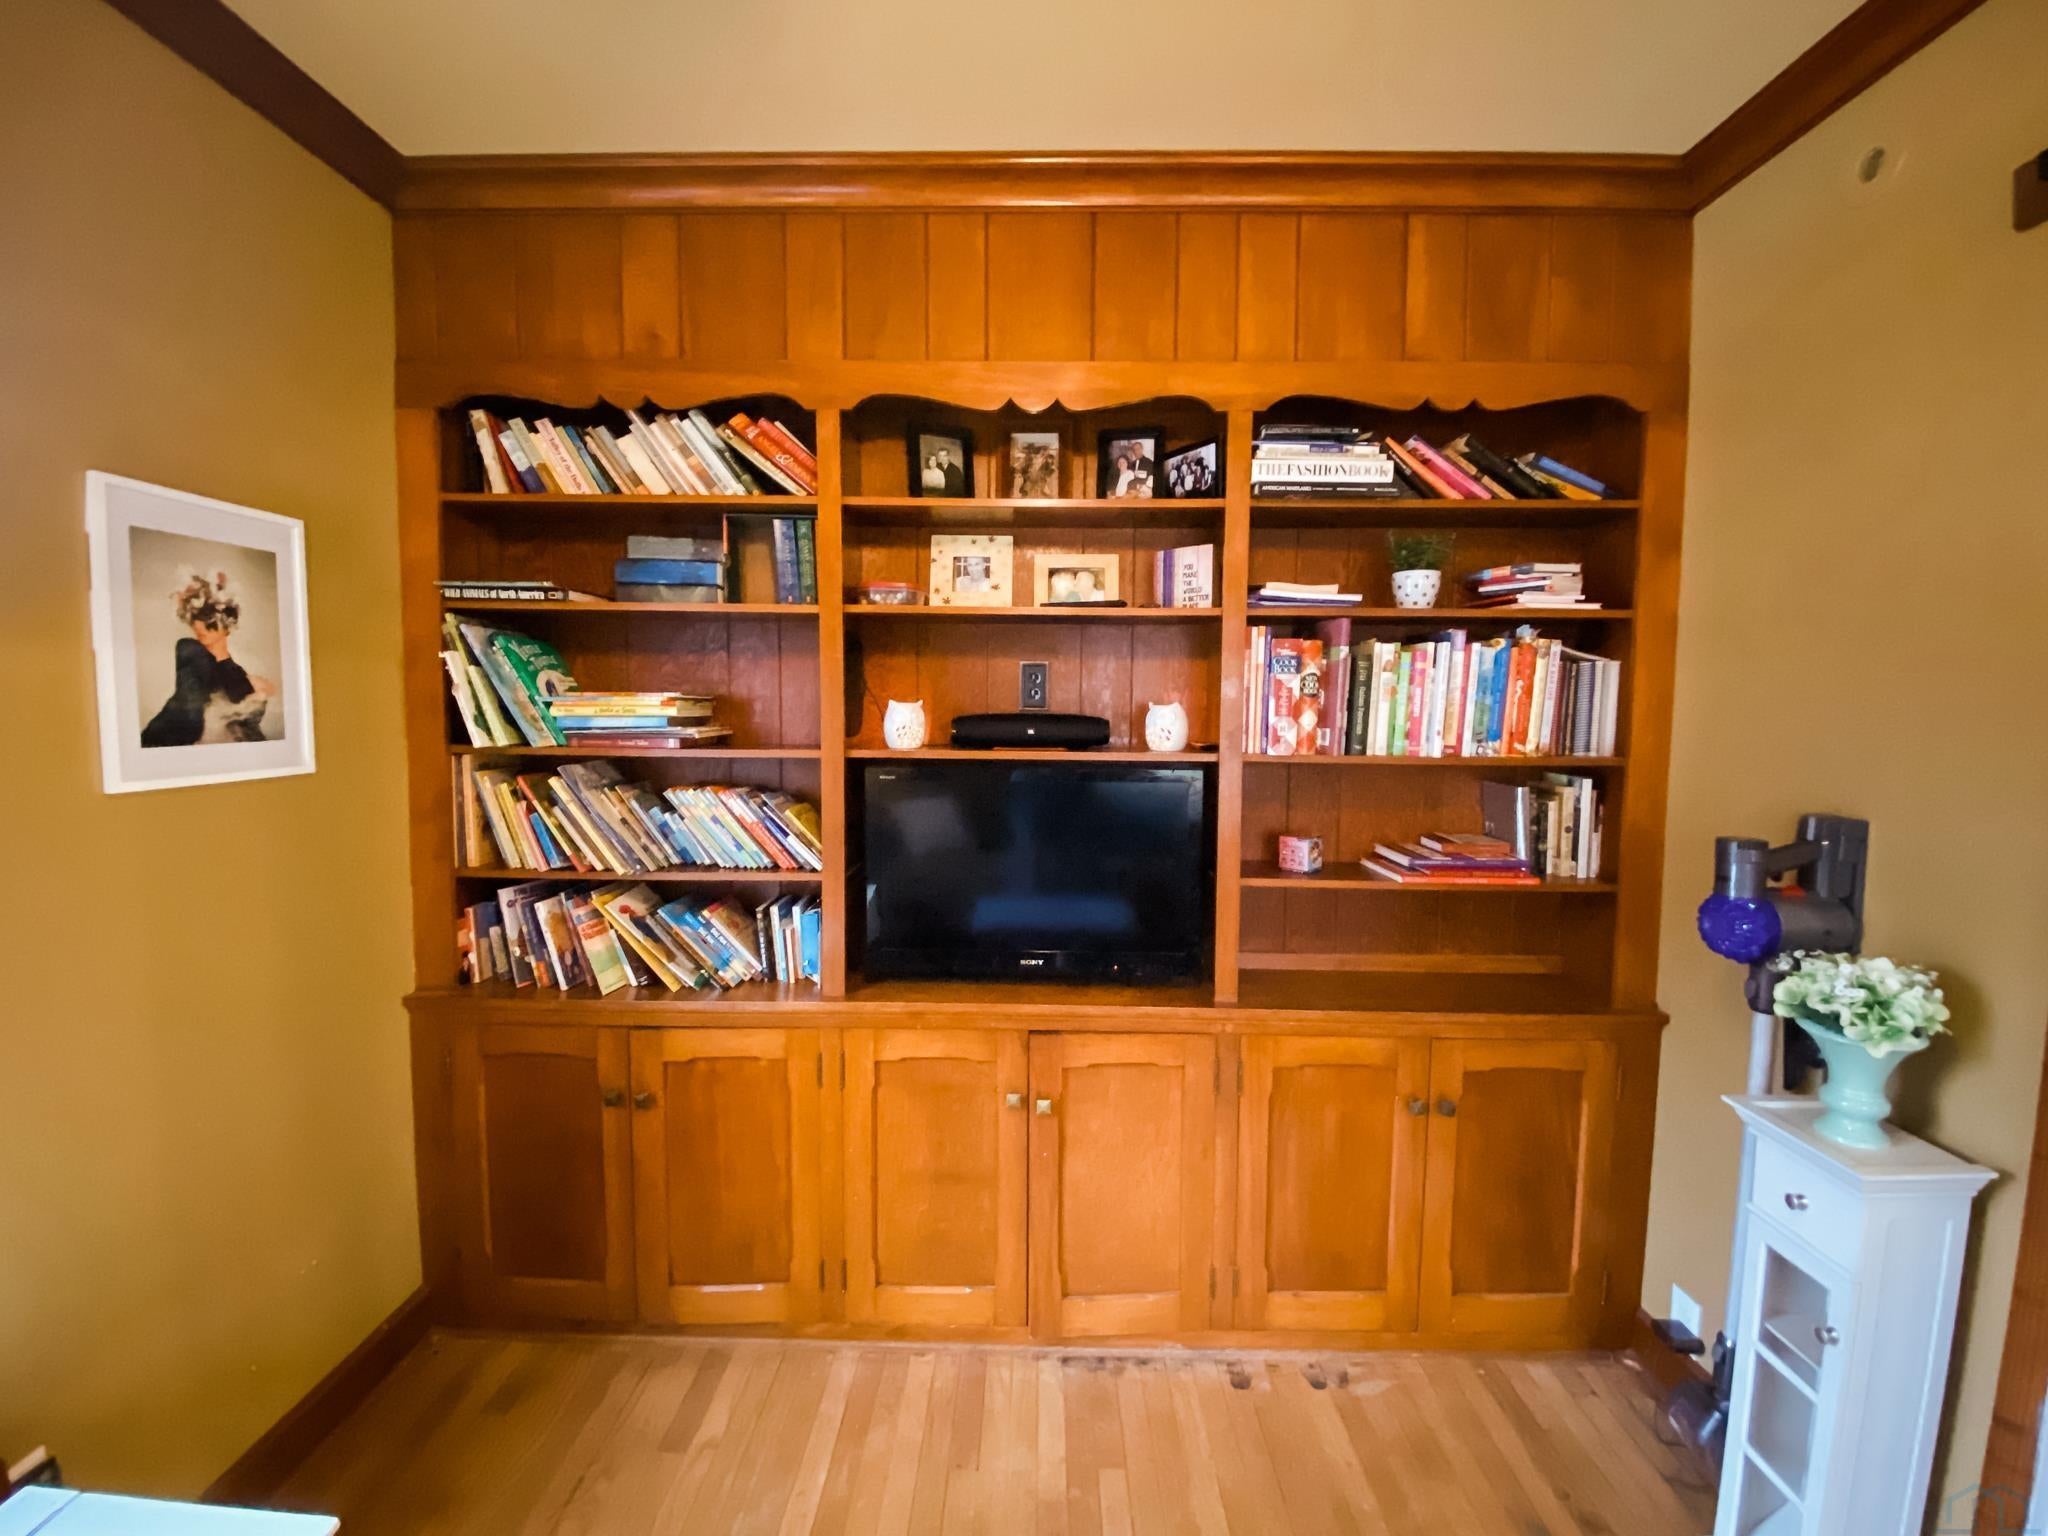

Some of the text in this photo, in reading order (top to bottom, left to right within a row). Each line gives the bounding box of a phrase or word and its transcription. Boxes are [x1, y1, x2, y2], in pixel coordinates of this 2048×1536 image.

[1257, 463, 1390, 477] THE FASHION BOOK
